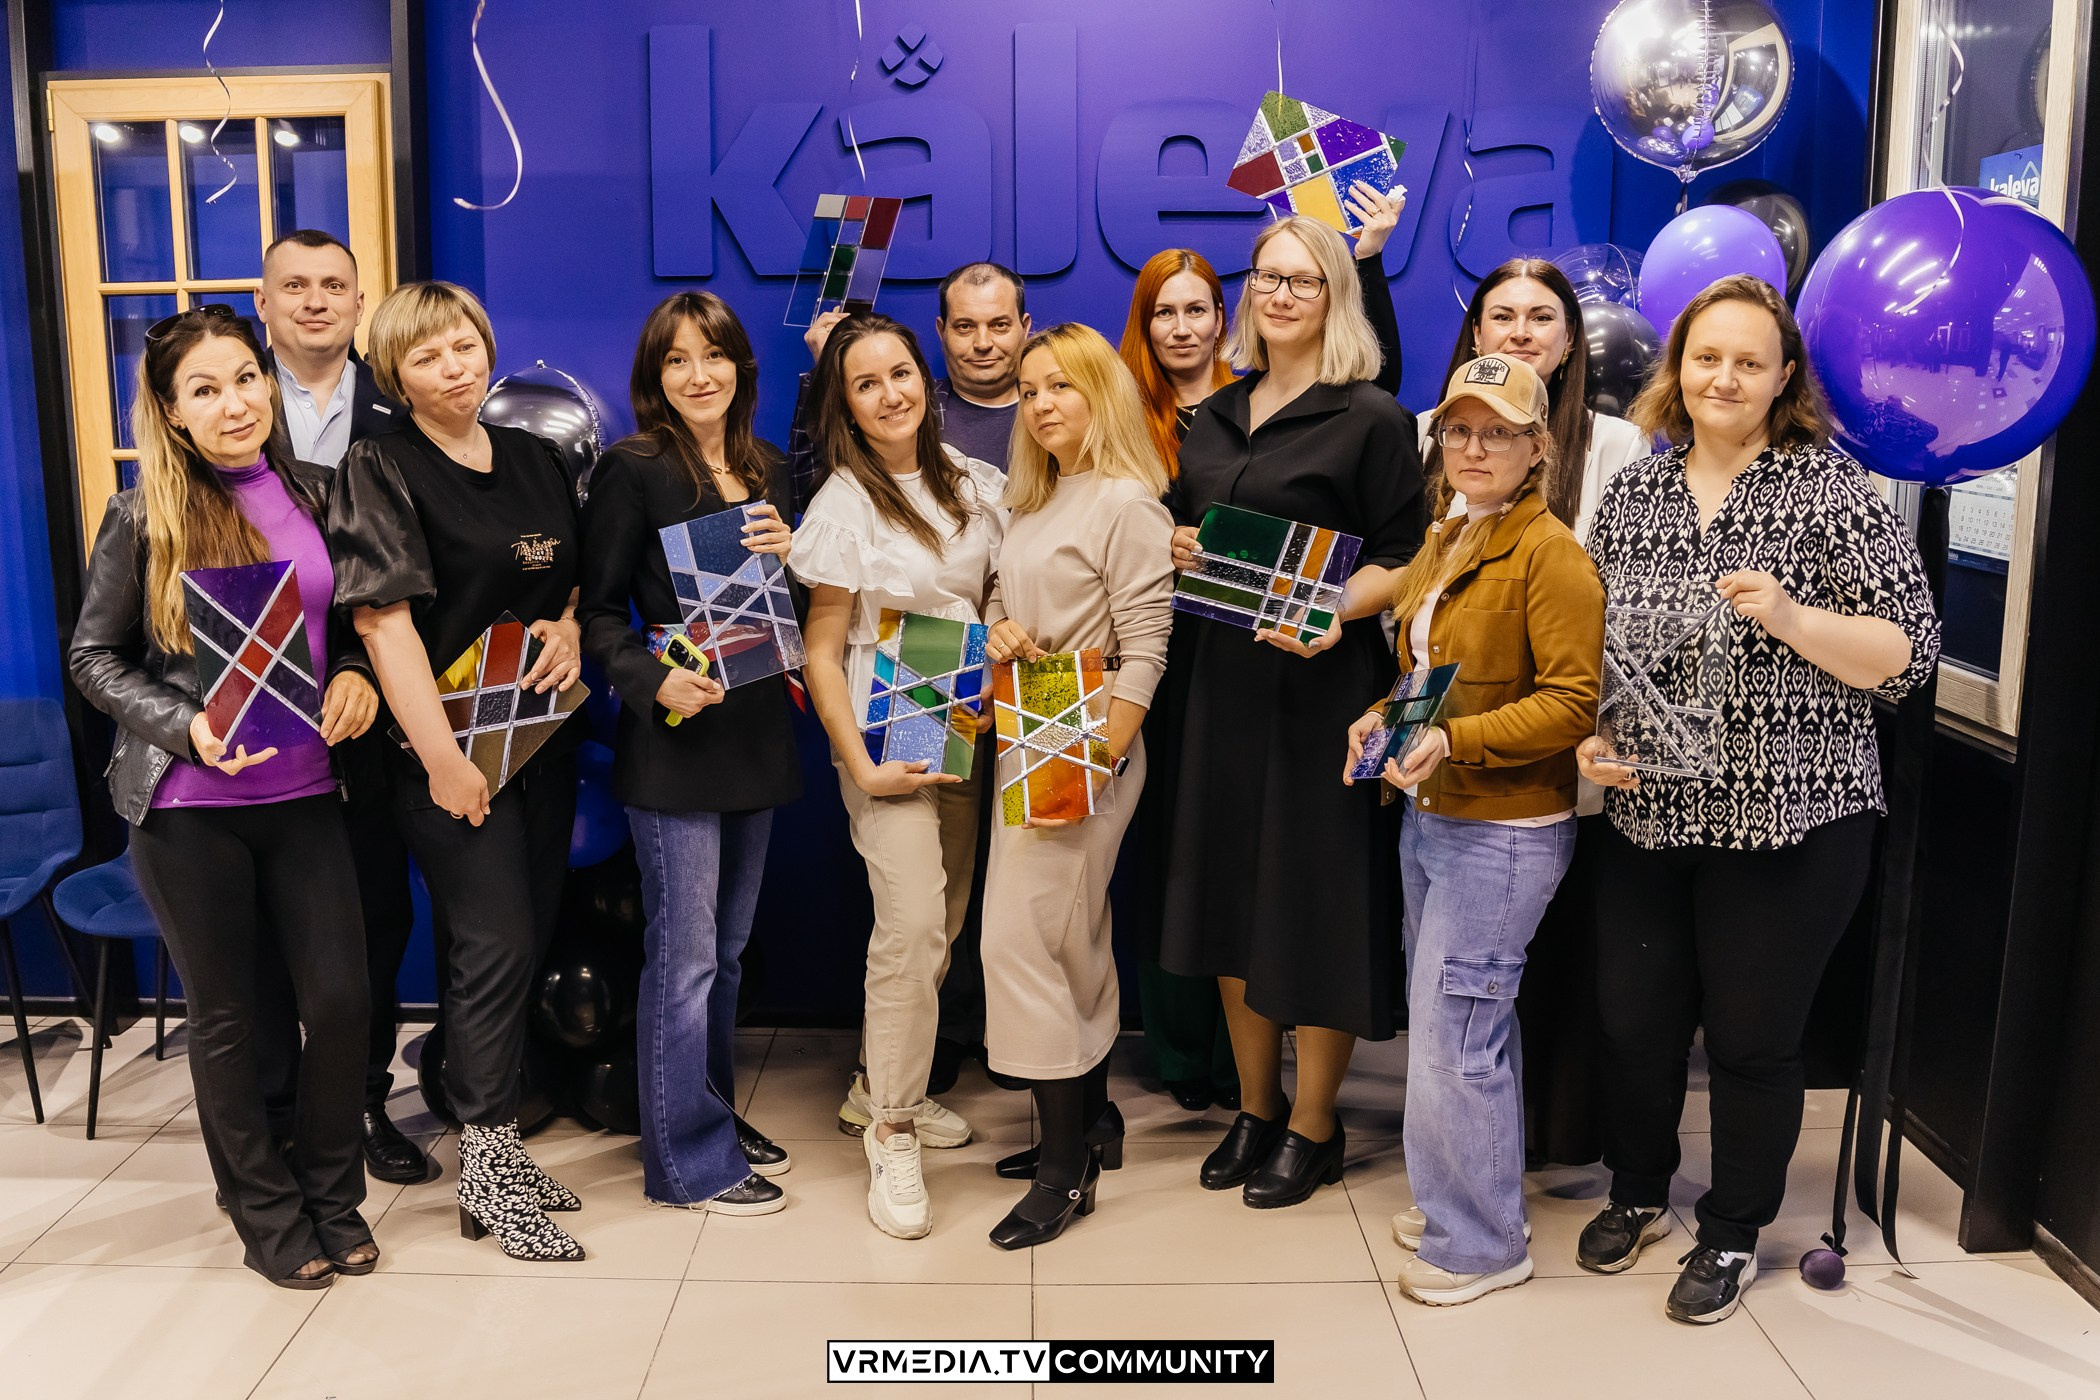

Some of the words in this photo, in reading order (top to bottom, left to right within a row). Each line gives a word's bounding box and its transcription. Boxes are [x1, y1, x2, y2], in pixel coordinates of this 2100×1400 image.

[1990, 174, 2040, 199] kaleva
[1968, 516, 1974, 524] 10
[1983, 519, 1989, 527] 12
[1989, 530, 1996, 538] 20
[1962, 535, 1969, 543] 24
[1970, 537, 1977, 545] 25
